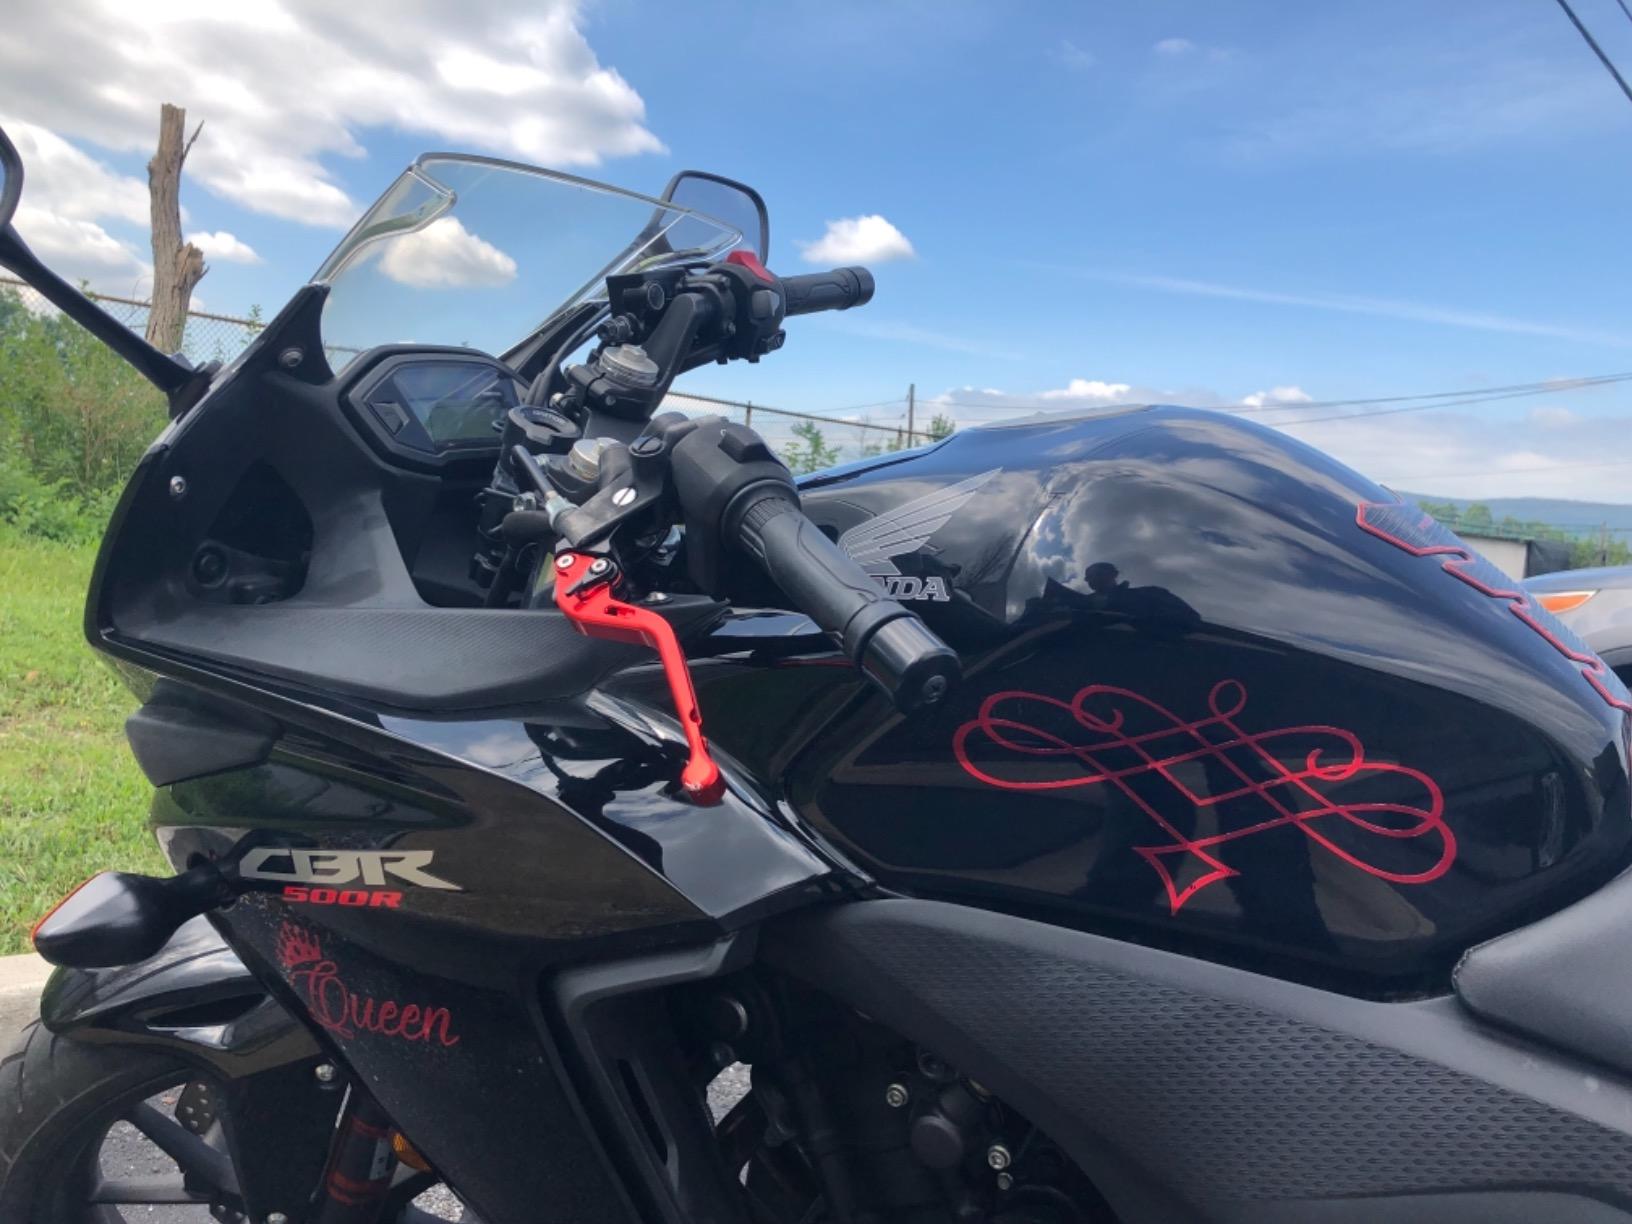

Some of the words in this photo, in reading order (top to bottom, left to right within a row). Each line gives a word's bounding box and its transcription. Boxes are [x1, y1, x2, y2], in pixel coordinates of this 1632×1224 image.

[239, 849, 463, 890] CBR
[282, 886, 403, 908] 500R
[290, 961, 460, 1046] Queen
